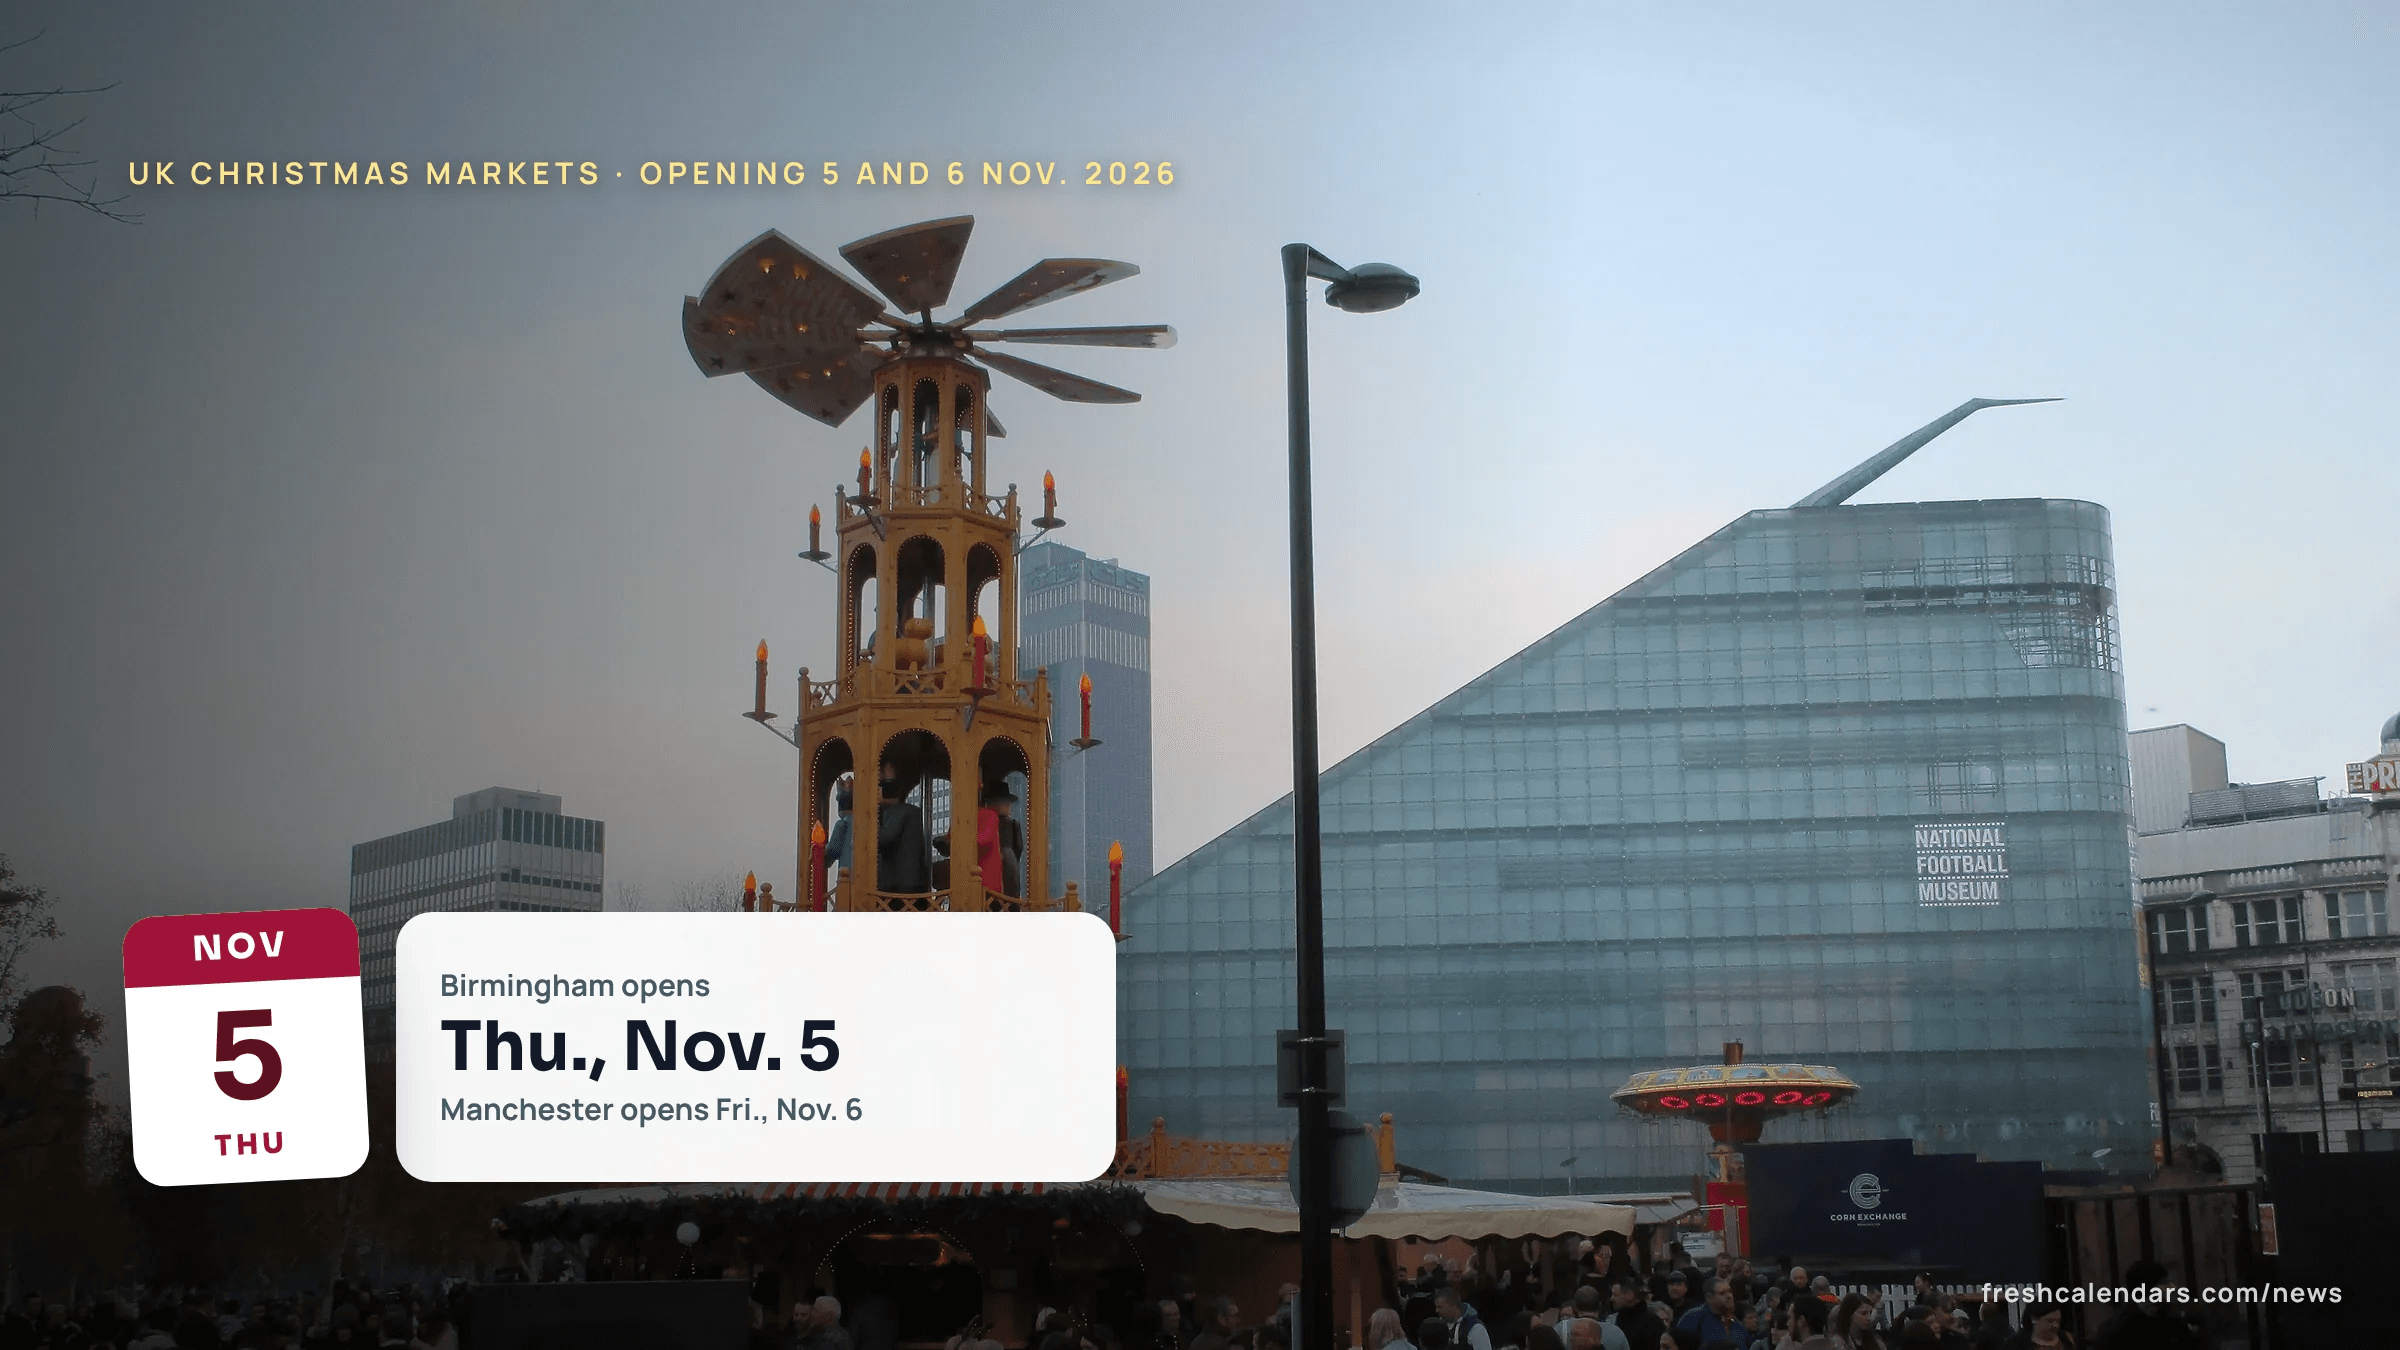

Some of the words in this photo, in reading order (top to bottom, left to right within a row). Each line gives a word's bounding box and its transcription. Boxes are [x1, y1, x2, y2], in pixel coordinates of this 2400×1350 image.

[1915, 828, 2005, 848] NATIONAL
[1917, 854, 2008, 875] FOOTBALL
[1918, 881, 1998, 901] MUSEUM
[1857, 1212, 1907, 1221] EXCHANGE
